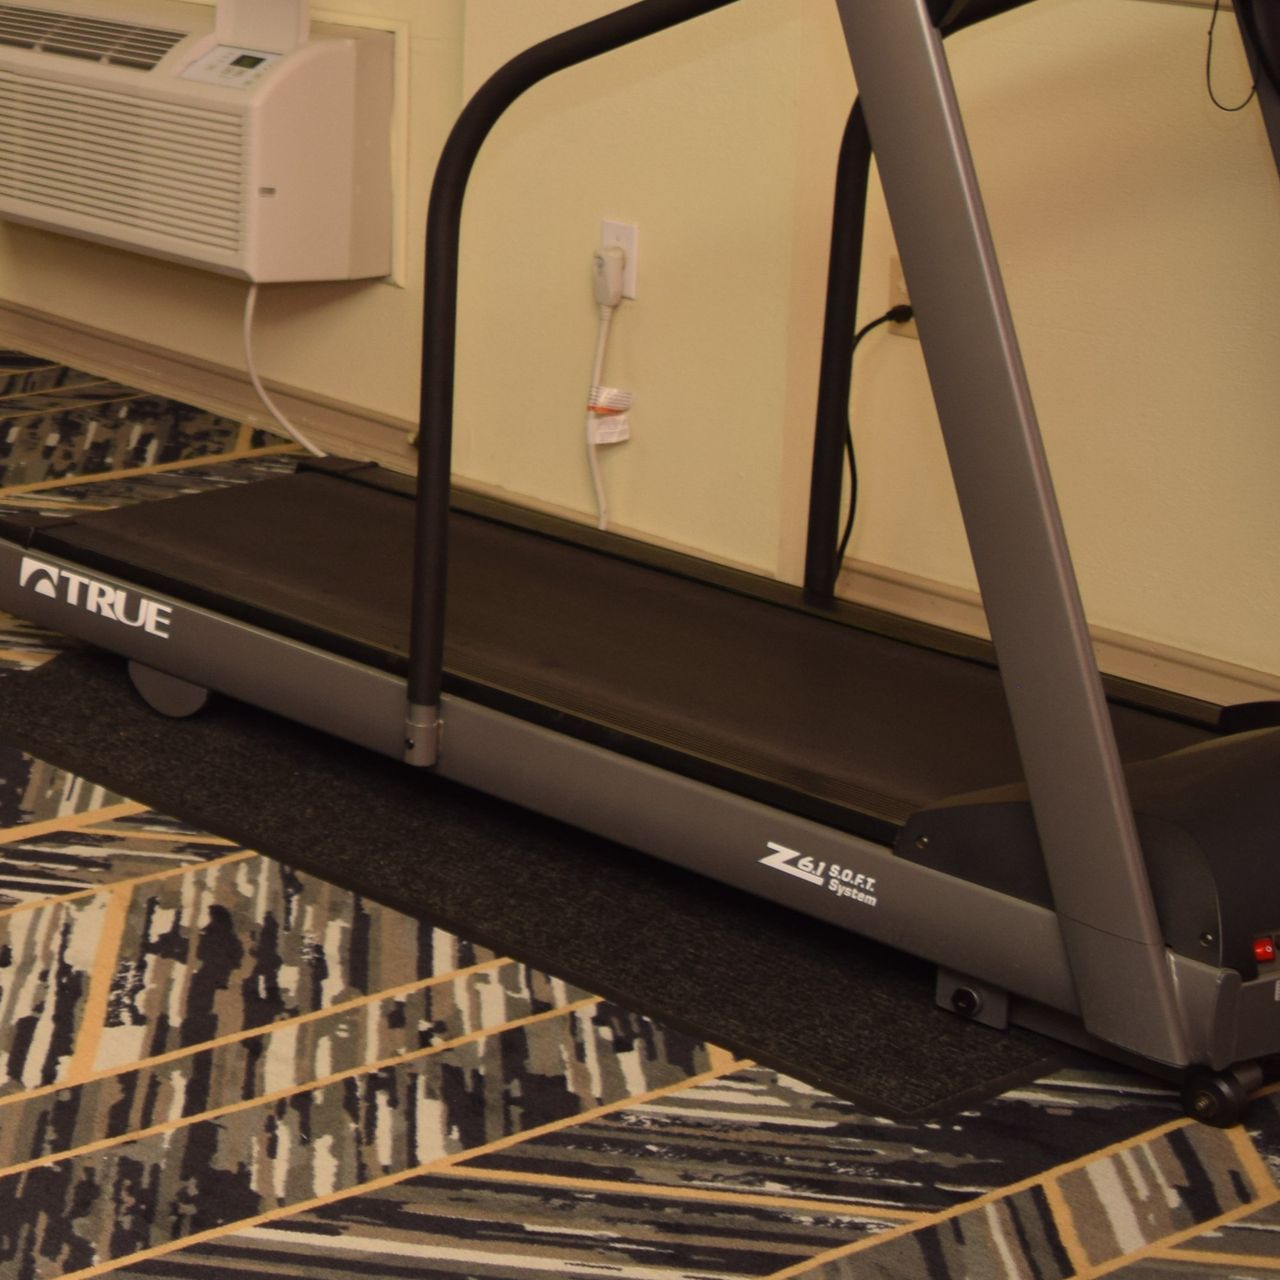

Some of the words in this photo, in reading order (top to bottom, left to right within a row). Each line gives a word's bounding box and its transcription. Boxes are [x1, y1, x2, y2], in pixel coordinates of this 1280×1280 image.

[60, 570, 173, 639] TRUE
[828, 864, 876, 892] S.O.F.T.
[828, 878, 877, 907] System
